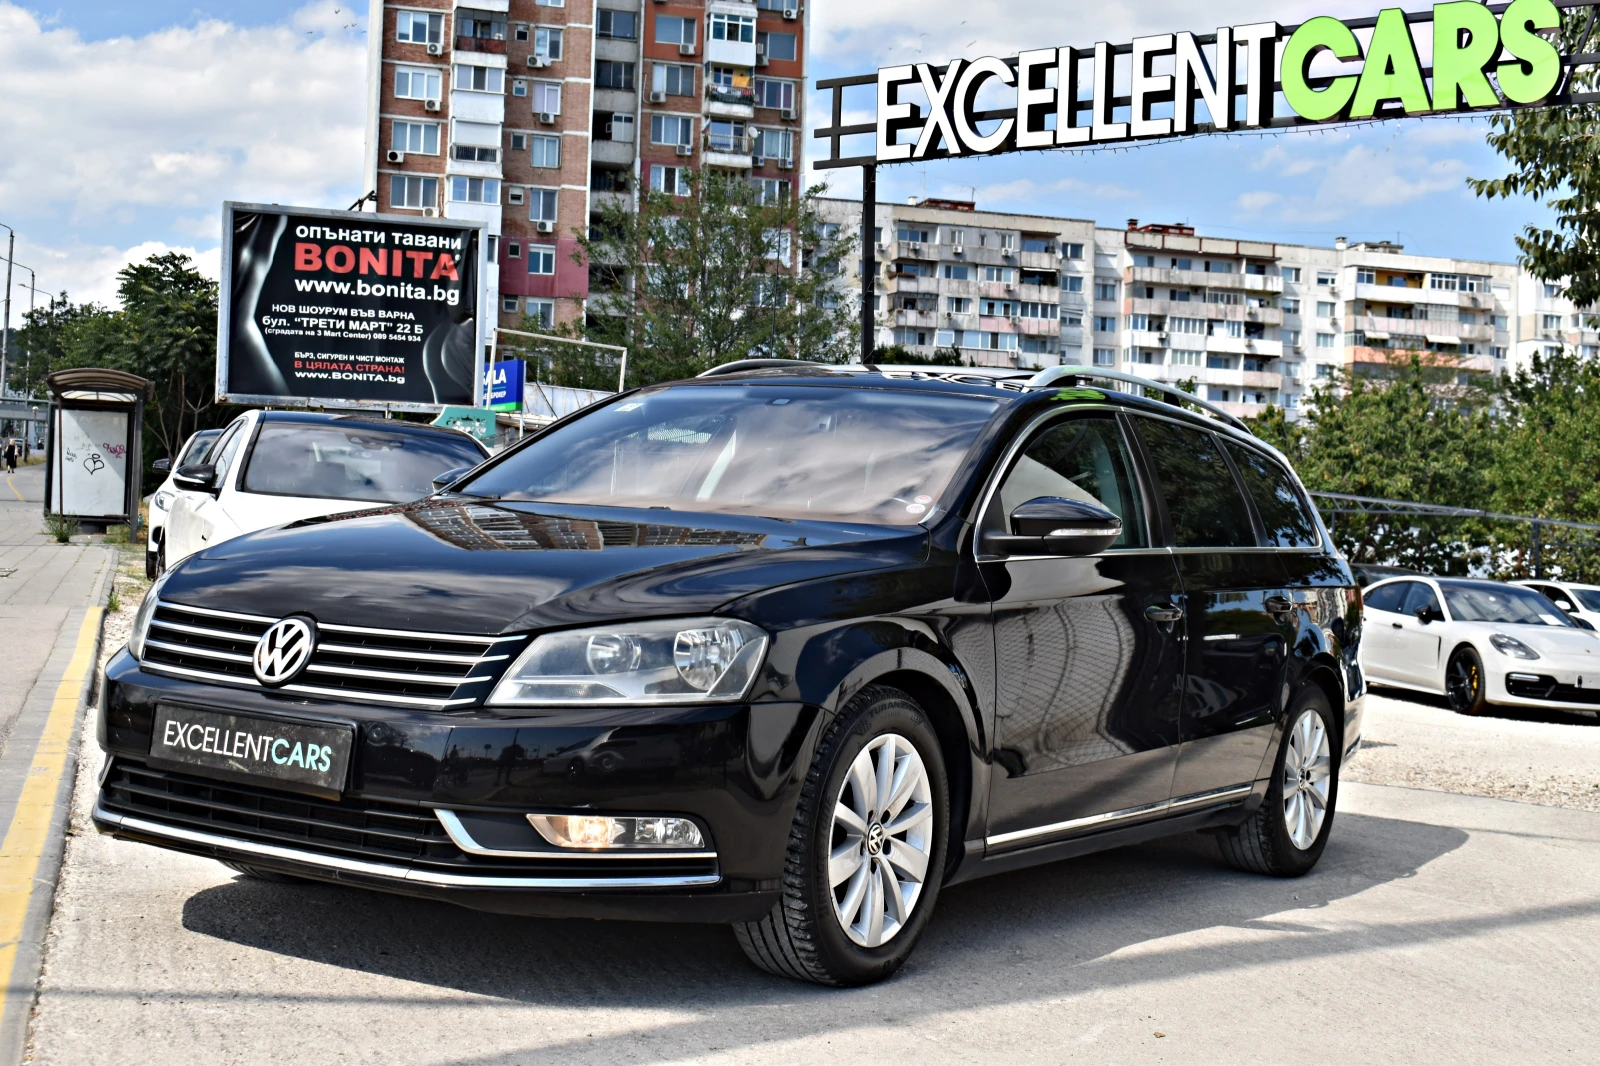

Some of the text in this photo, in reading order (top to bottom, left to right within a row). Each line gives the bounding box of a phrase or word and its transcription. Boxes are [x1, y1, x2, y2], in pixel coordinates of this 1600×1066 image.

[295, 225, 462, 250] опънати тавани
[294, 242, 460, 281] BONITA
[294, 279, 460, 306] www.bonita.bg
[272, 304, 416, 320] НОВ ШОУРУМ ВЪВ ВАРНА
[262, 316, 290, 327] бул.
[396, 323, 412, 334] 22
[414, 324, 424, 334] Б
[316, 329, 322, 337] 3
[324, 330, 341, 338] Mart
[317, 353, 348, 361] СИГУРЕН
[294, 360, 405, 374] В ЦЯЛАТА СТРАНА!
[294, 372, 406, 384] www.BONITA.bg
